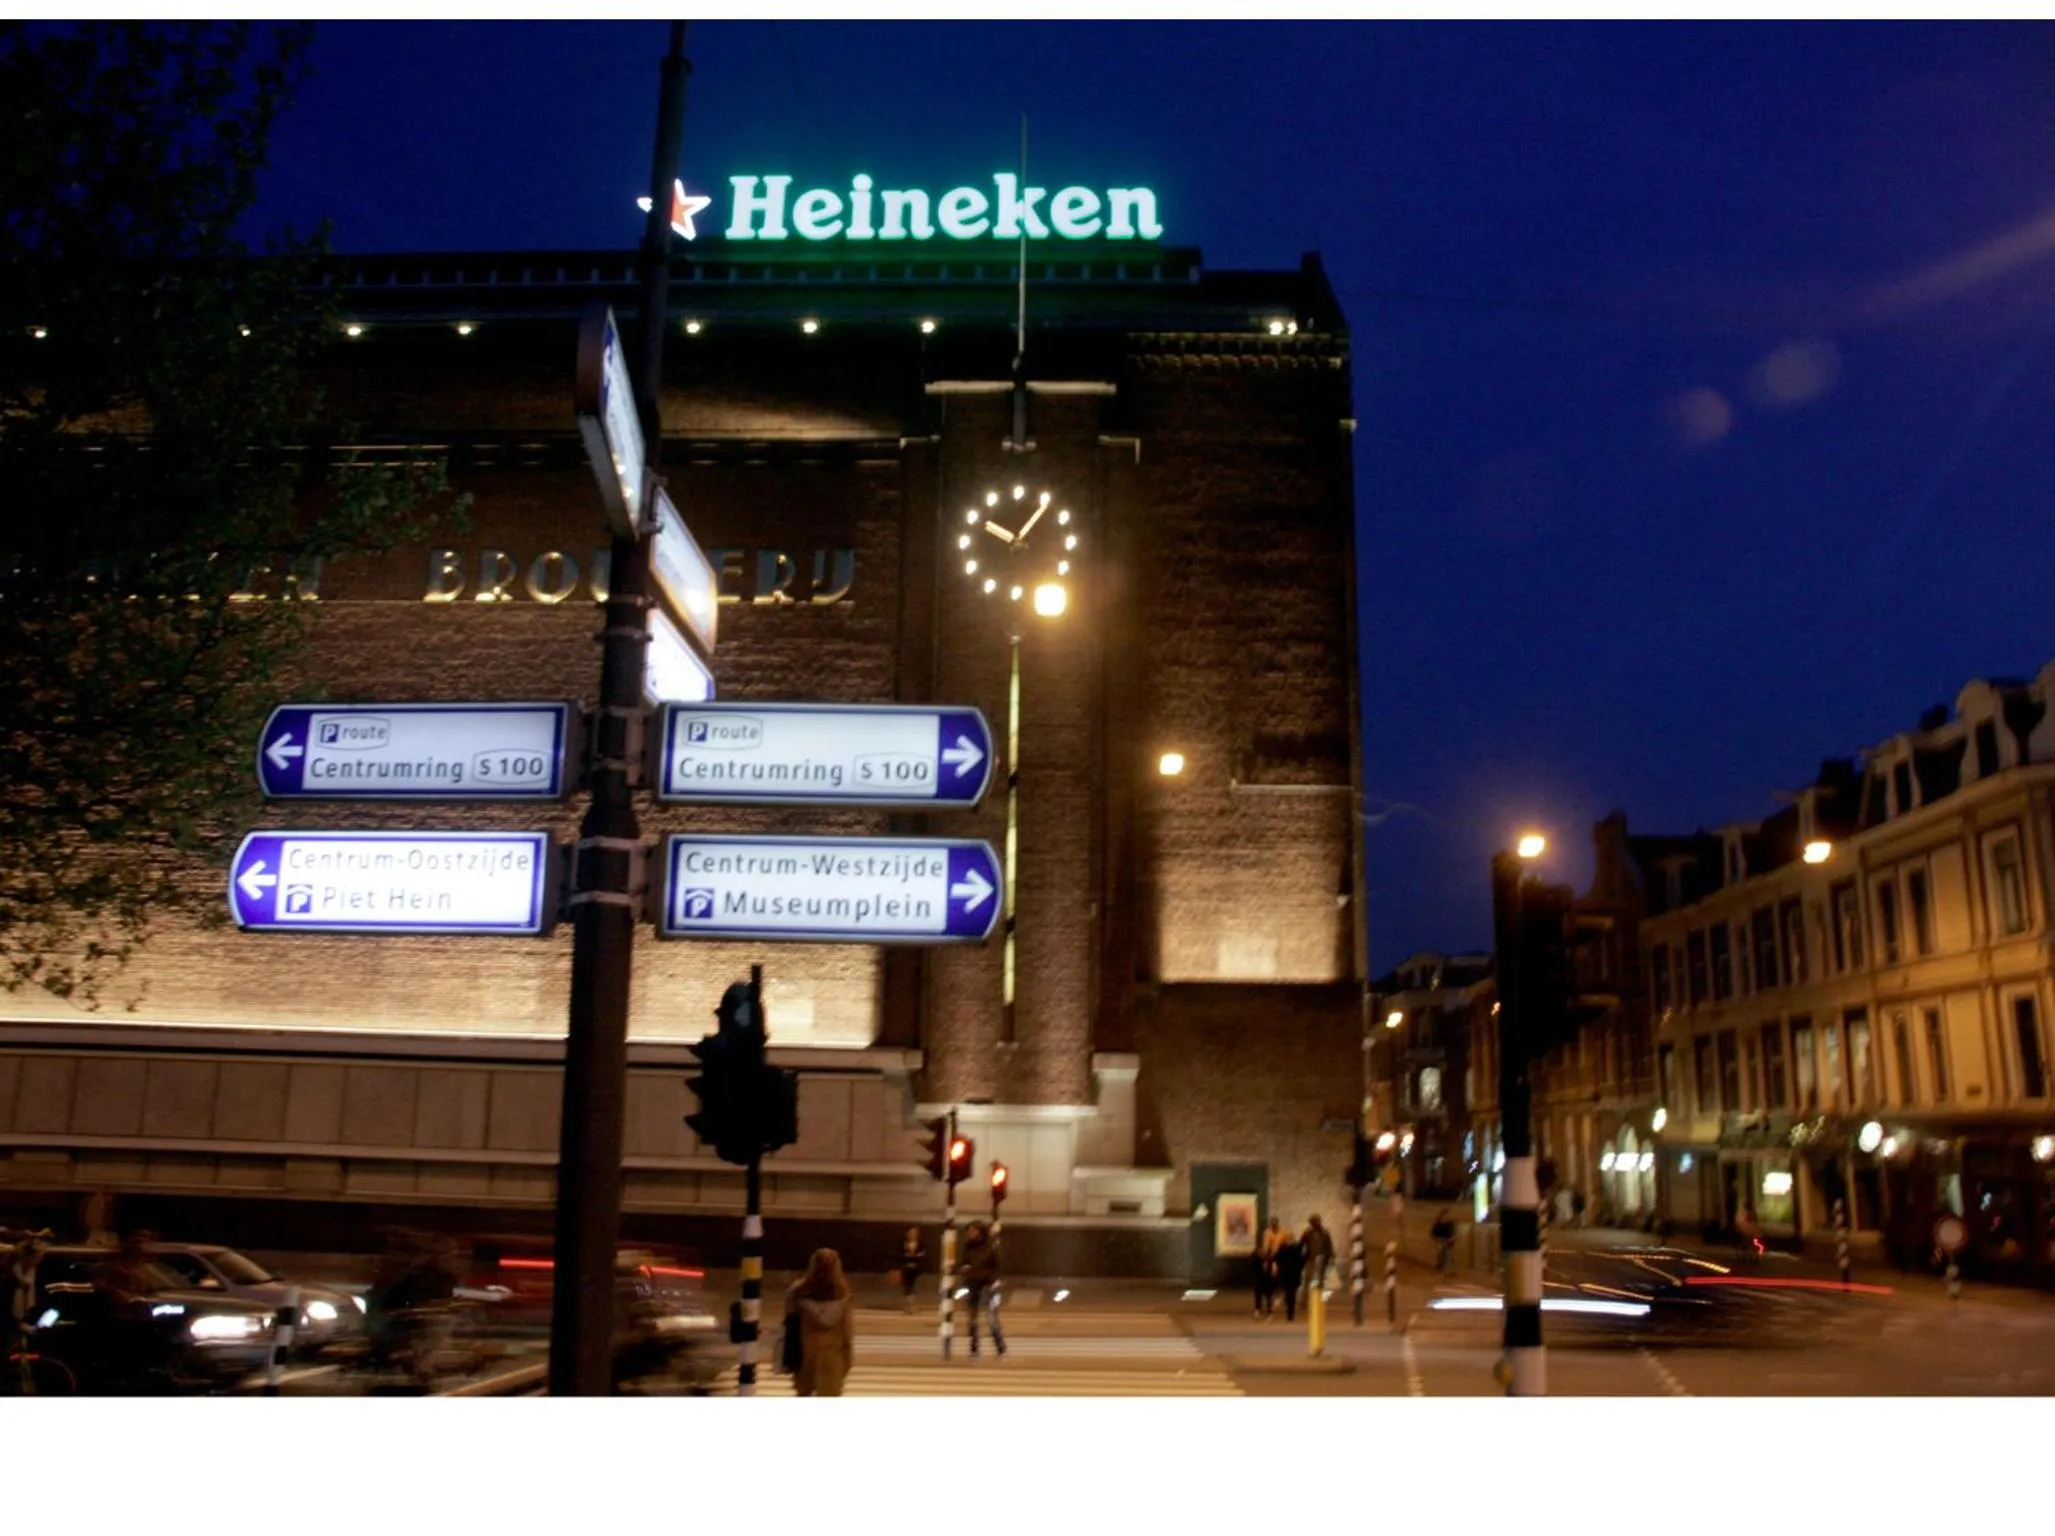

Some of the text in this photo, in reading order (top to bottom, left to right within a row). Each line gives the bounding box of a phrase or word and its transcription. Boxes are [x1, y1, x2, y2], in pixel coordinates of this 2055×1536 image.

[724, 172, 1163, 240] Heineken
[341, 724, 386, 741] route
[711, 724, 758, 741] route
[310, 757, 463, 783] Centrumring
[679, 757, 844, 786] Centrumring
[288, 848, 529, 877] Centrum-Oostzijde
[685, 851, 943, 882] Centrum-Westzijde
[322, 887, 376, 909] Piet
[388, 886, 451, 910] Hein
[724, 891, 931, 922] Museumplein
